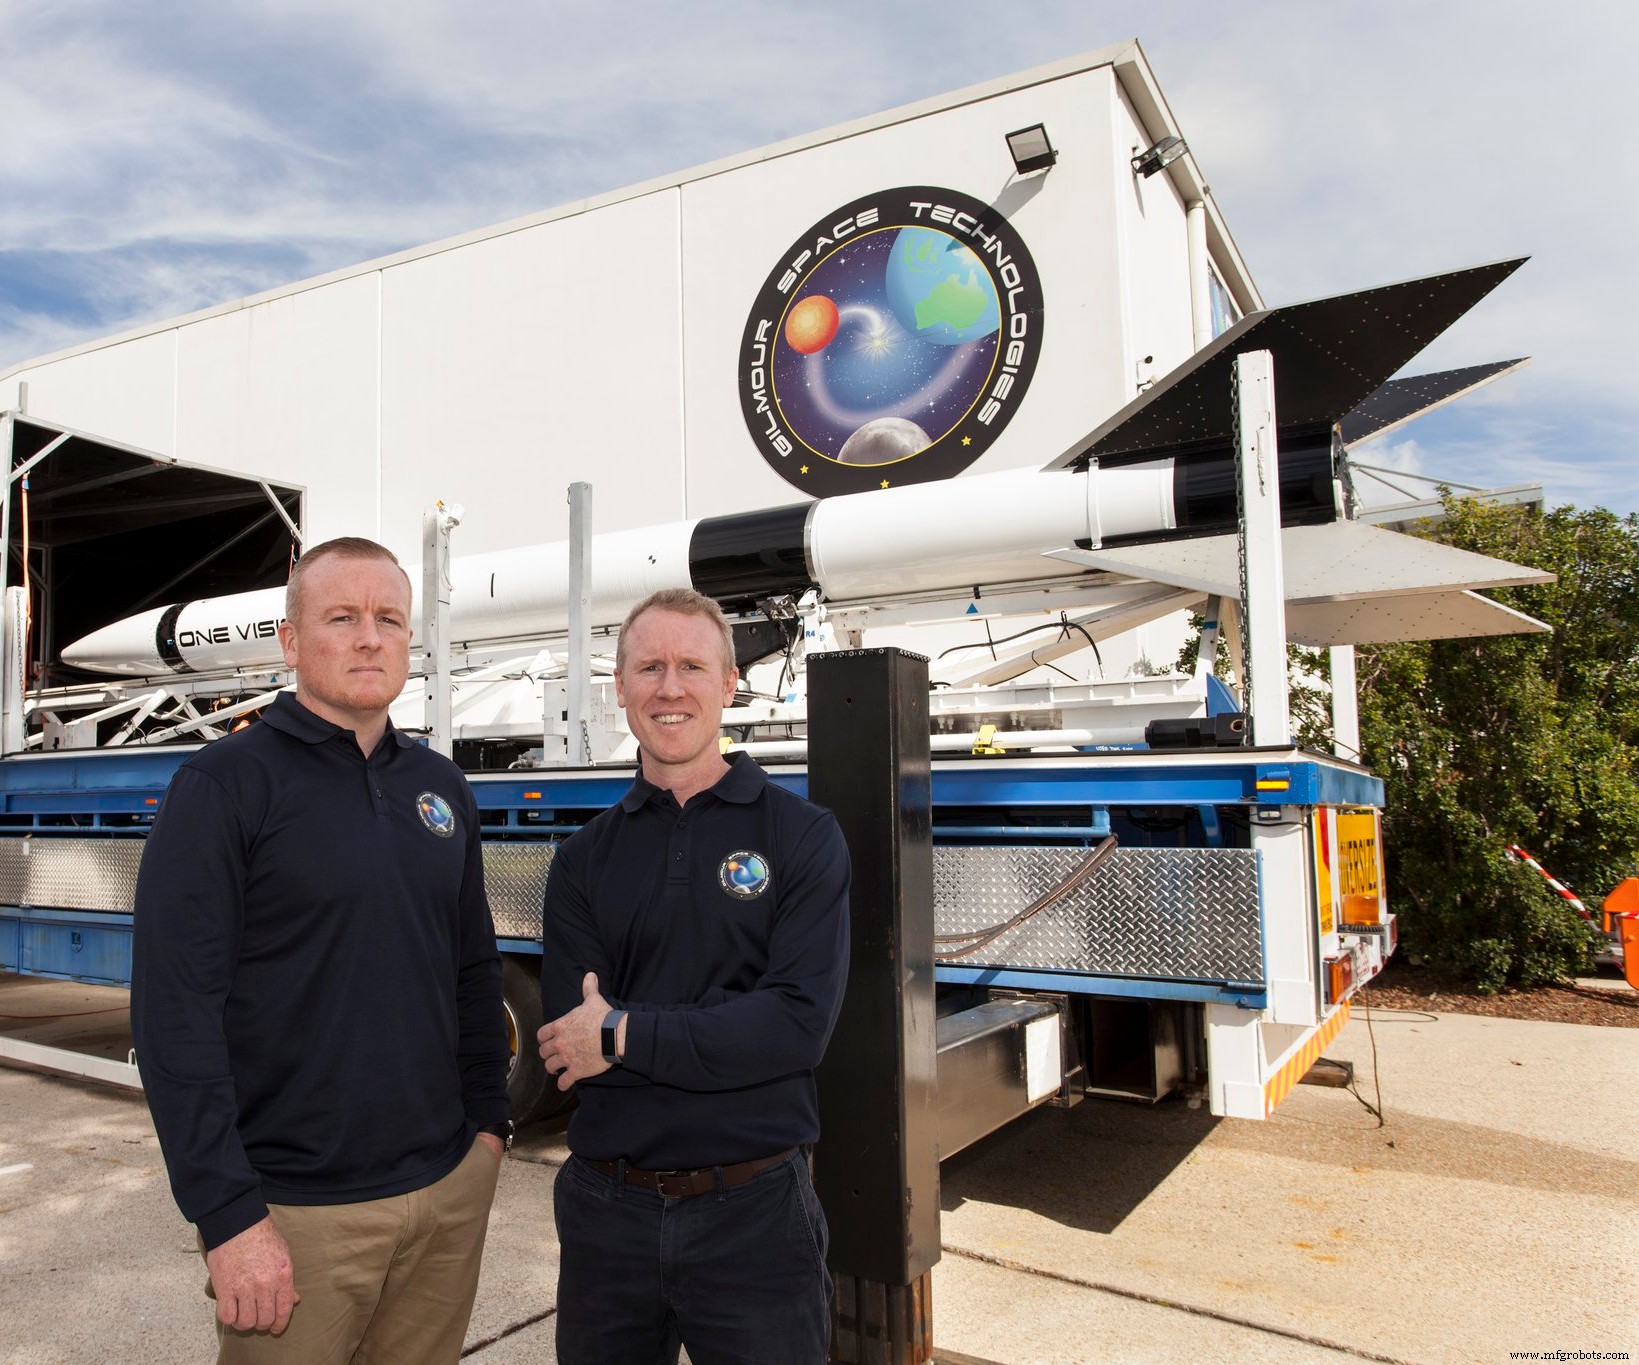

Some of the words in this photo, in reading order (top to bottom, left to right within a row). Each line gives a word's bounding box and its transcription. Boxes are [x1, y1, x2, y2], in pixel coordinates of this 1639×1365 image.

[751, 319, 793, 457] GILMOUR
[777, 207, 879, 294] SPACE
[909, 202, 1027, 426] TECHNOLOGIES
[179, 626, 231, 648] ONE
[235, 618, 287, 641] VISI
